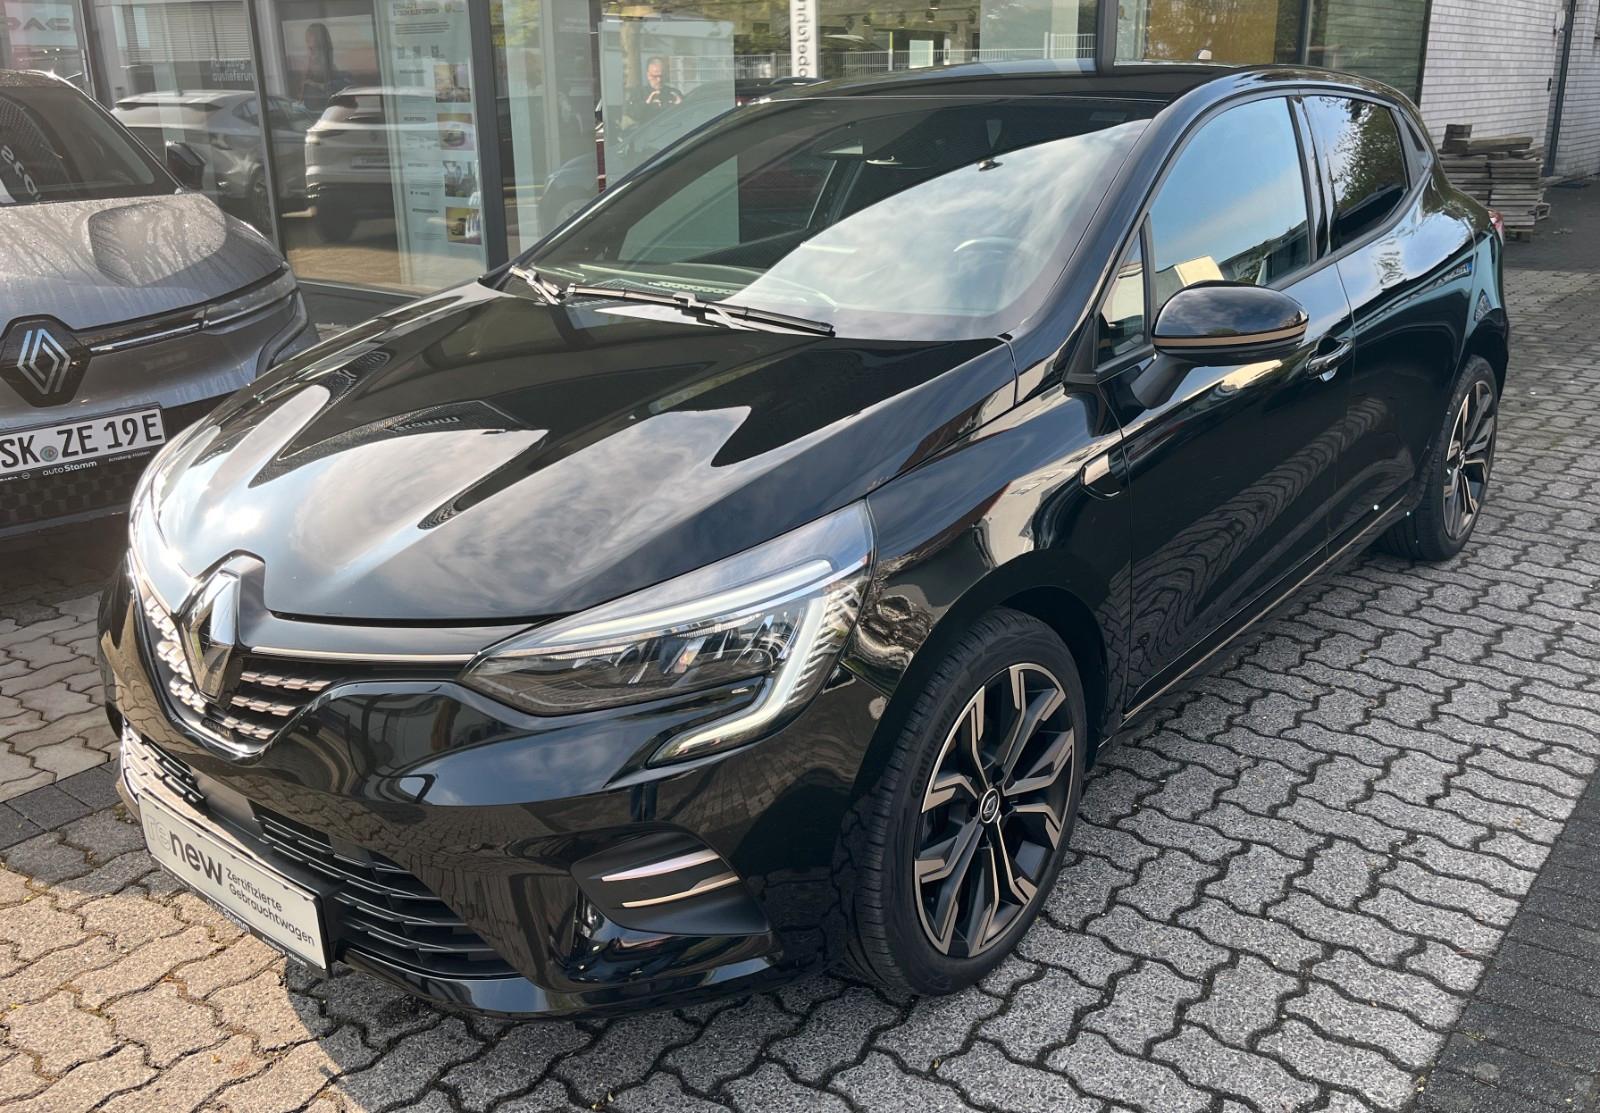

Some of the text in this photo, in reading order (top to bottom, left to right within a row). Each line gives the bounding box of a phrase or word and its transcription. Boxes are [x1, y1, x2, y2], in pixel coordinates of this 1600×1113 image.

[57, 425, 99, 458] ZE
[104, 413, 163, 450] 19E
[226, 867, 283, 912] Zertifizierte
[229, 883, 316, 947] Gebrauchtwagen
